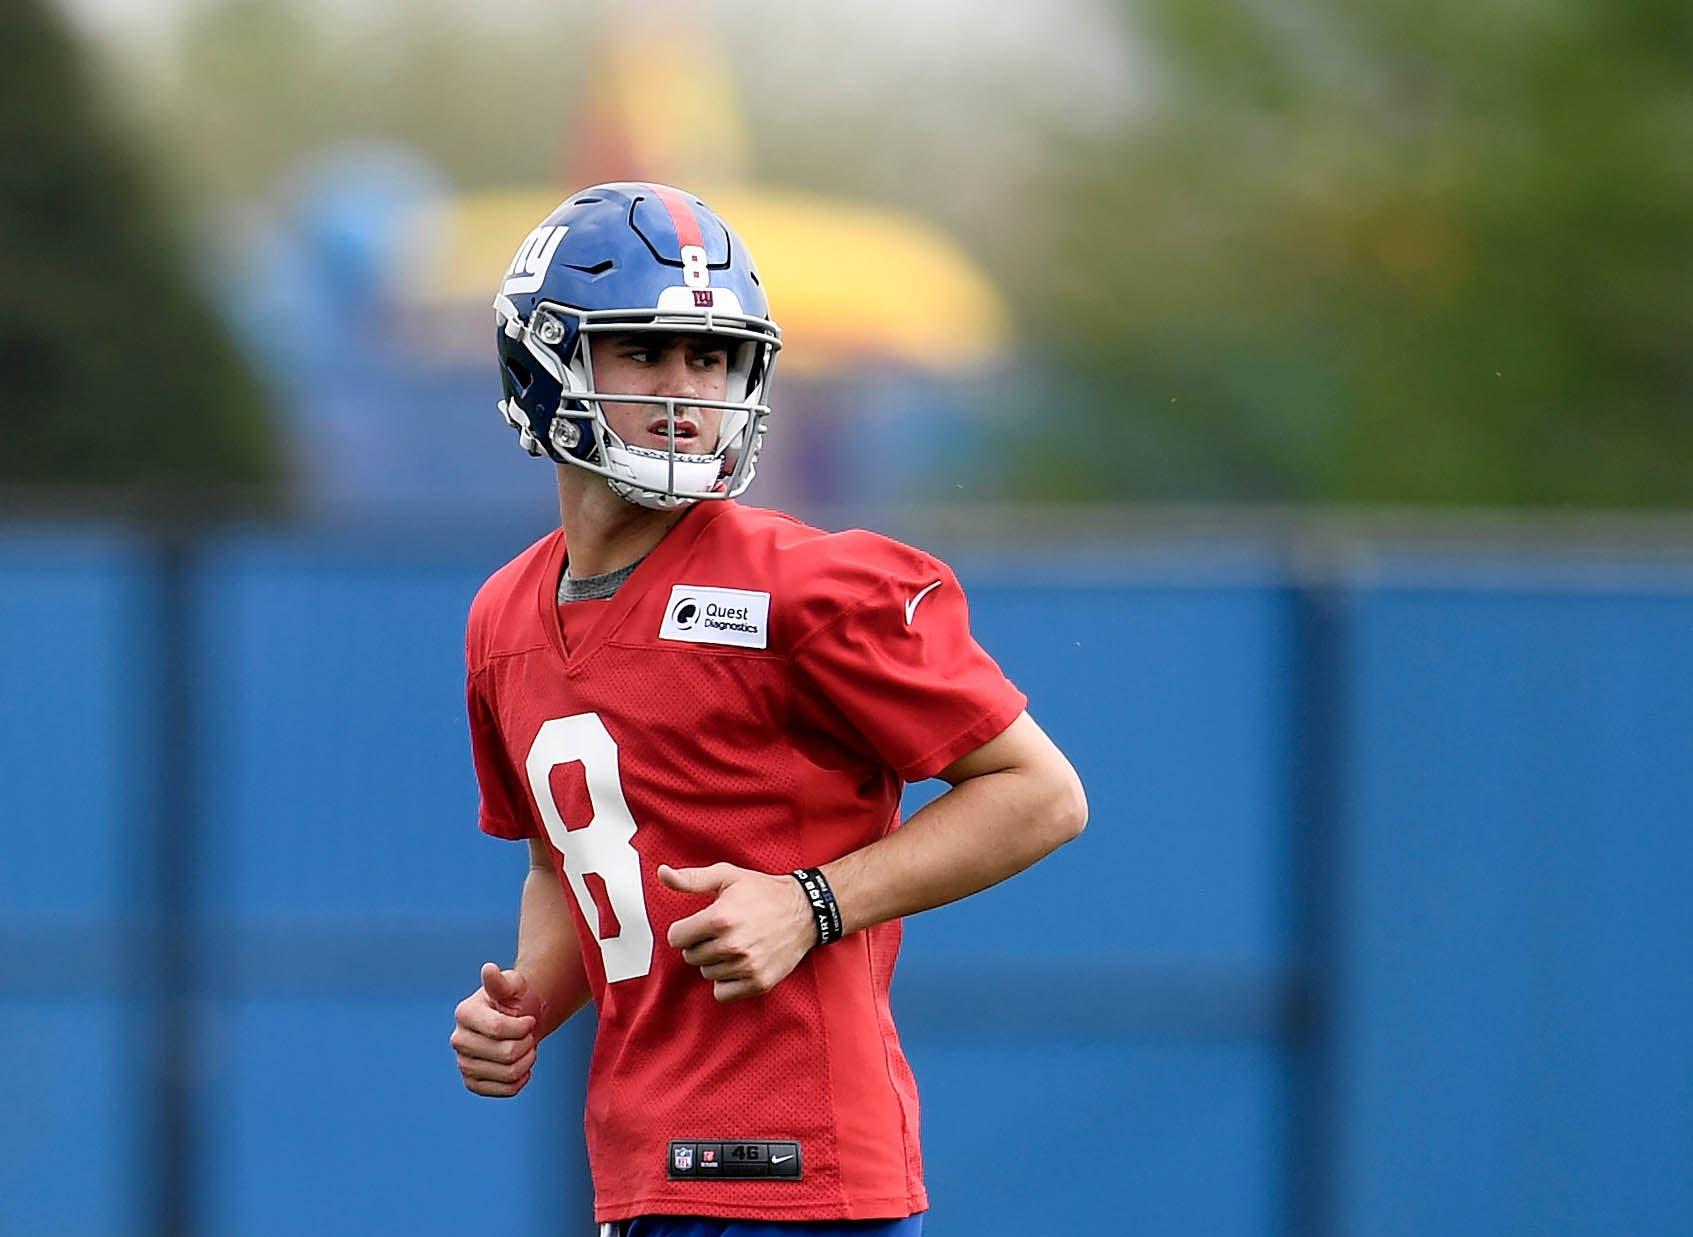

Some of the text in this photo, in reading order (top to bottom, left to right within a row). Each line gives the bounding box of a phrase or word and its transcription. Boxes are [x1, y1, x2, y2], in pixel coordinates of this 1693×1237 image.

[680, 245, 711, 288] 8
[704, 618, 758, 634] Diagnostics
[706, 602, 749, 620] Quest
[525, 711, 655, 984] 8
